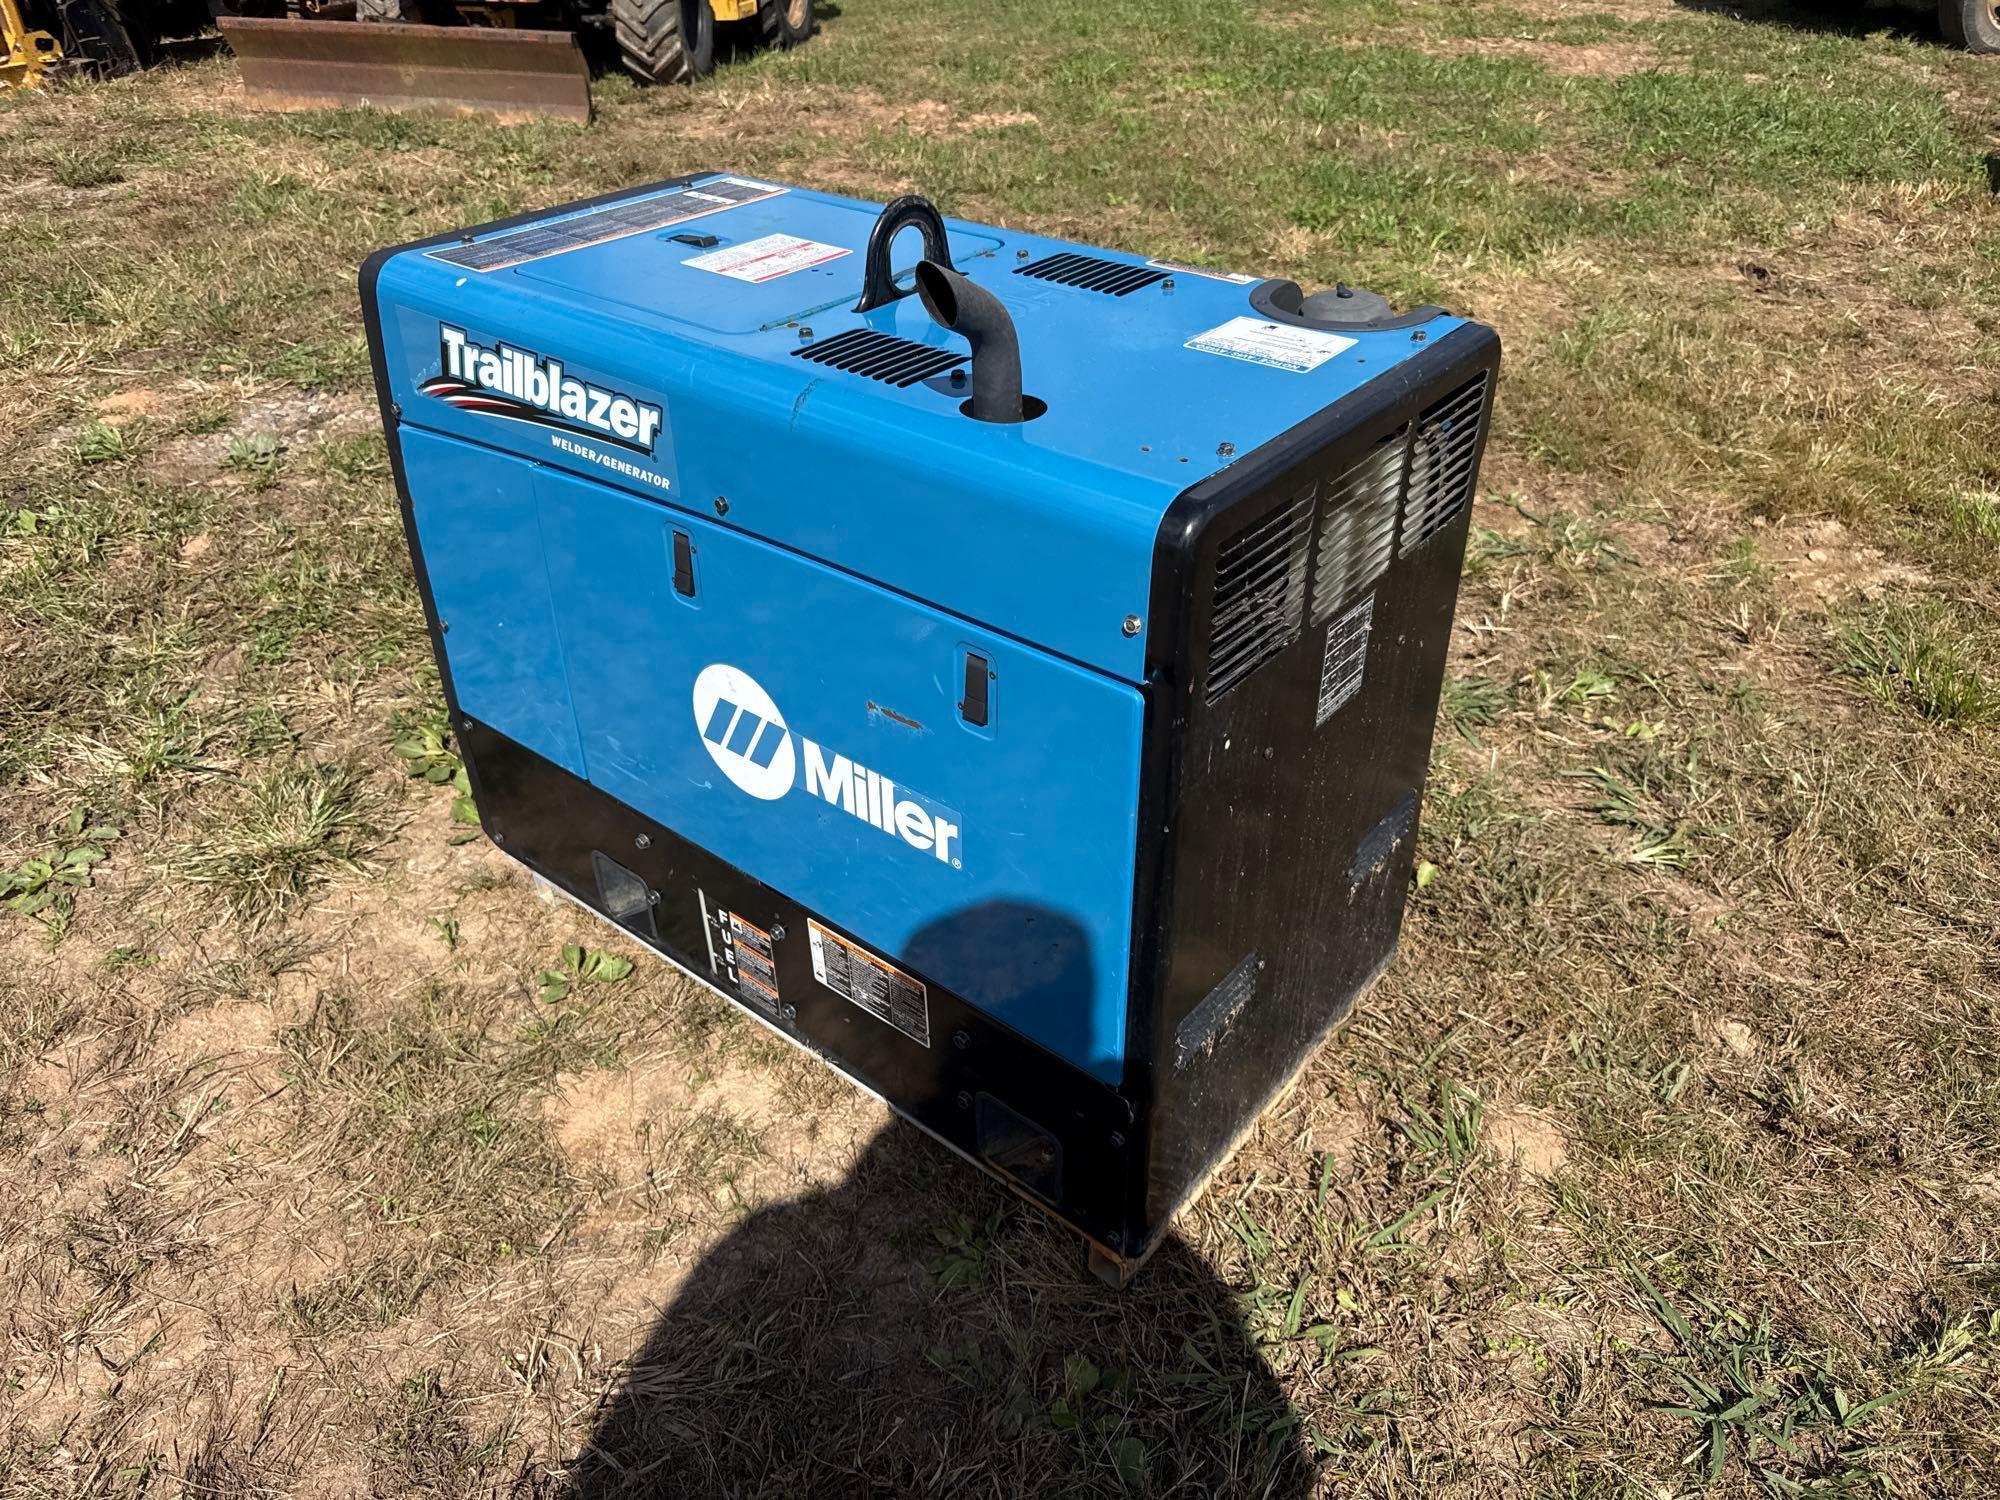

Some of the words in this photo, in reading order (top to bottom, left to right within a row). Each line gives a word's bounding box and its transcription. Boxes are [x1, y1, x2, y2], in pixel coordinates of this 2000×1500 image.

[442, 327, 660, 446] Trailblazer
[551, 434, 671, 490] WELDER/GENERATOR
[802, 737, 958, 864] Miller
[718, 909, 739, 984] FUEL
